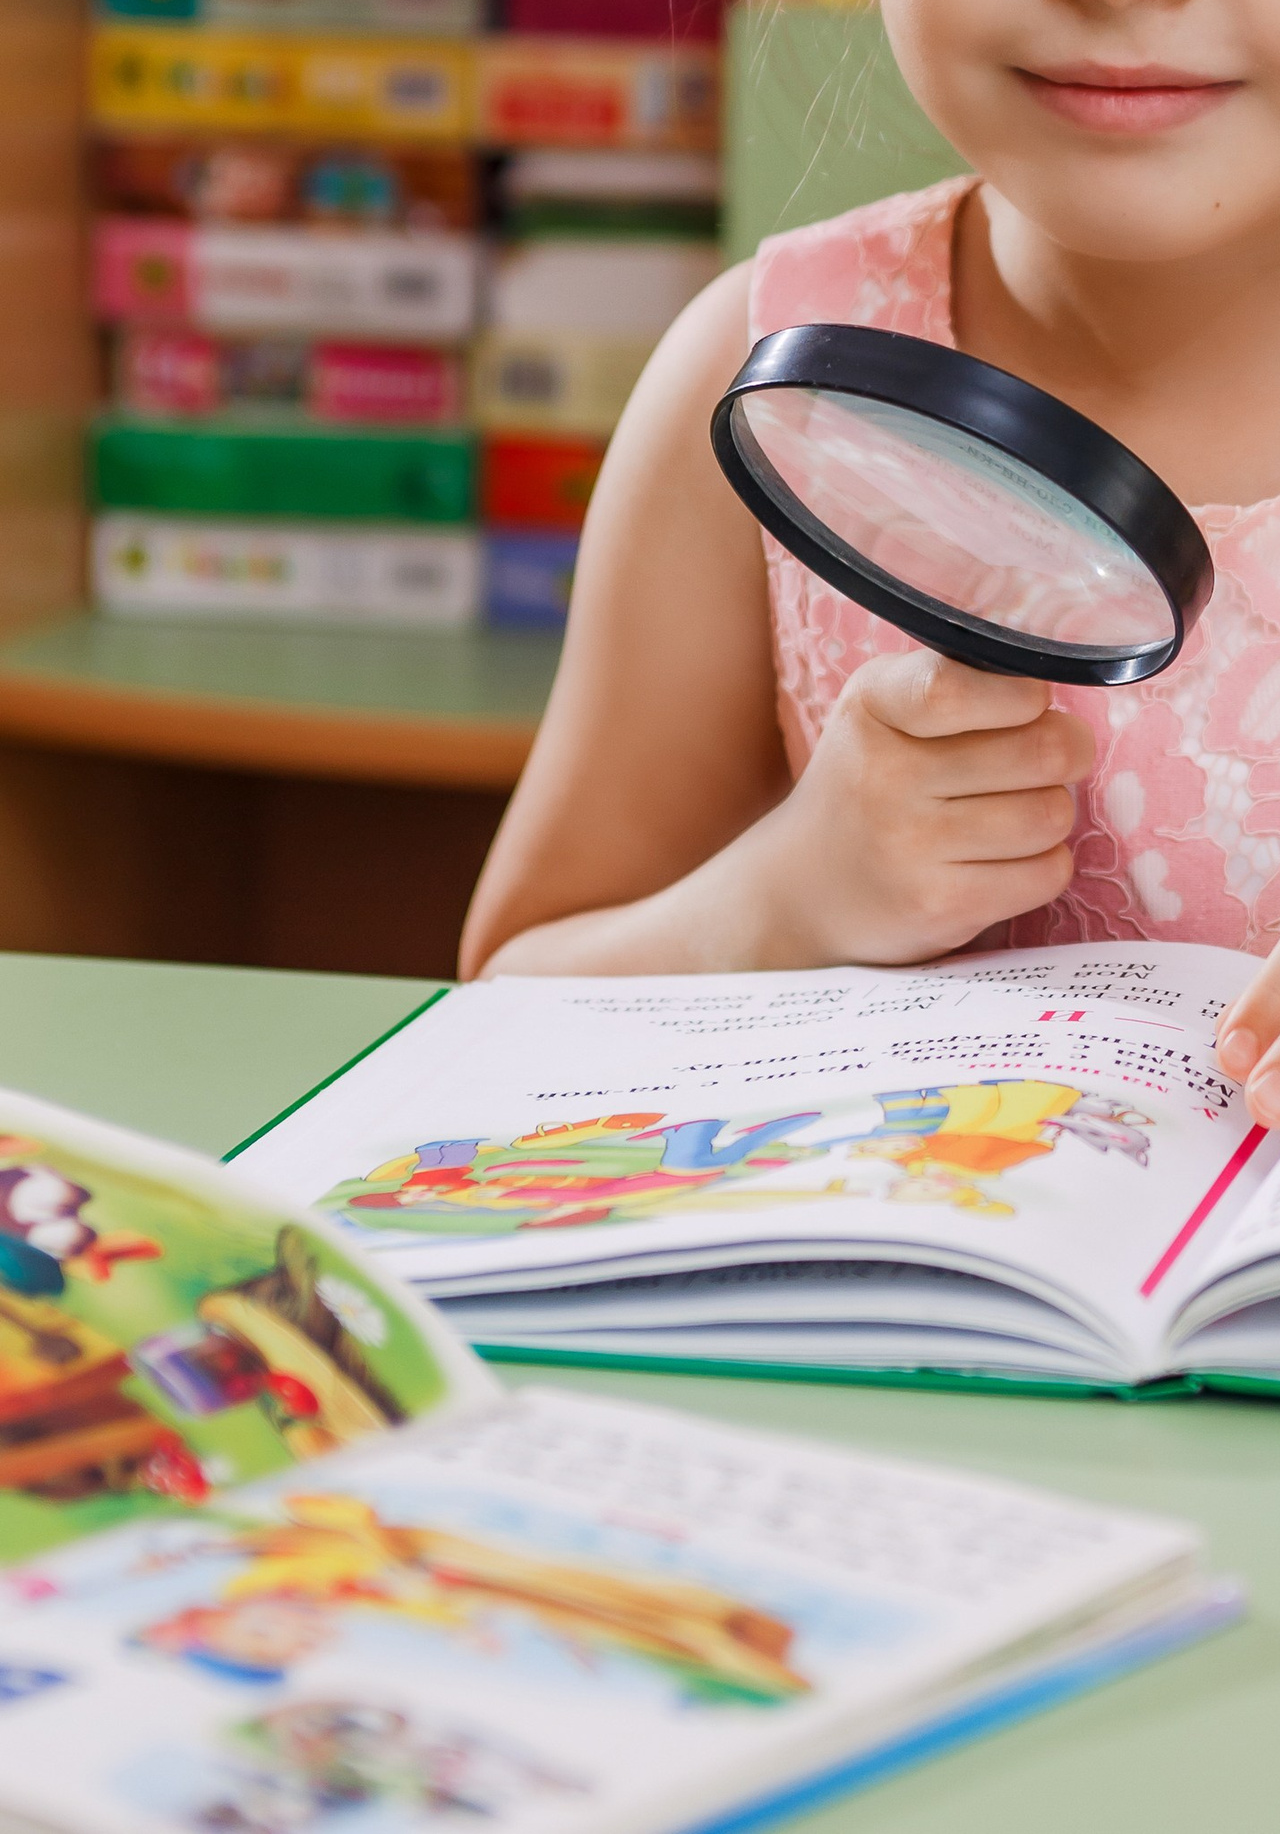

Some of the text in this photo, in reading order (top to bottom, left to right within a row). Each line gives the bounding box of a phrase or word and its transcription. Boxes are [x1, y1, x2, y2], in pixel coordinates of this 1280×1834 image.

[1073, 971, 1150, 980] Мой
[1081, 963, 1158, 972] Мои
[993, 983, 1182, 998] ша-ри-ки.
[1024, 992, 1175, 1007] ша-рик.
[1029, 1010, 1094, 1023] И
[892, 1033, 1041, 1050] от-крой
[1067, 1033, 1195, 1064] Па-па,
[672, 1046, 866, 1073] ма-ши-ну.
[902, 1051, 1044, 1063] па-пой.
[745, 1062, 871, 1082] Ма-ша
[1117, 1050, 1239, 1099] Ма-ма
[1114, 1060, 1229, 1108] Са-ша
[527, 1084, 679, 1102] ма-мой.
